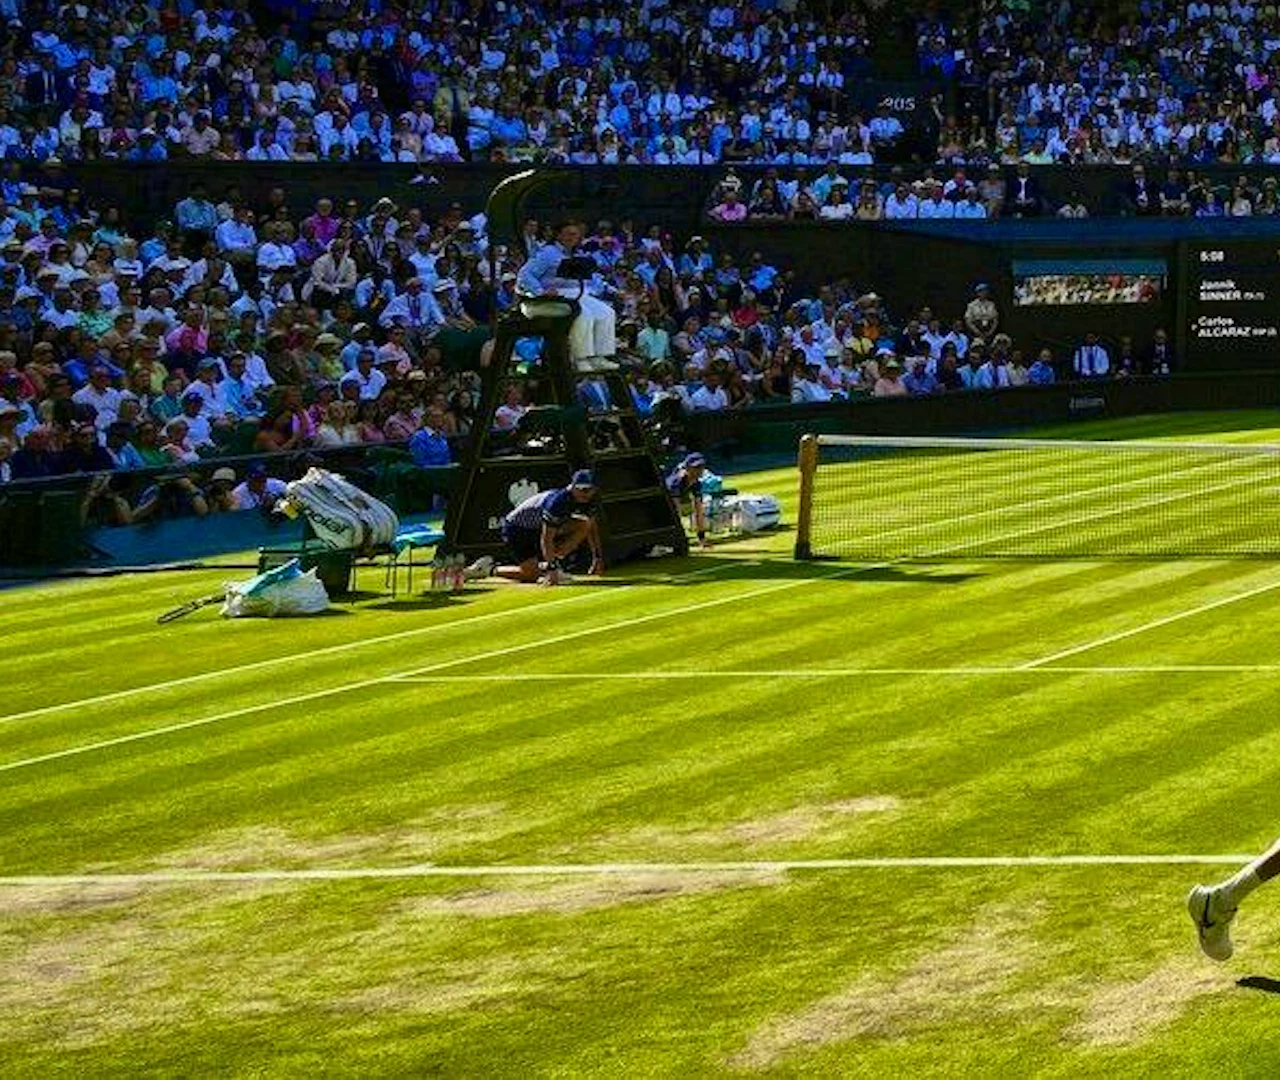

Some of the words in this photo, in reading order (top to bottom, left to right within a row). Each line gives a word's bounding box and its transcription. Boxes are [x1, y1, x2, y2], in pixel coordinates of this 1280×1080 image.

[1200, 279, 1236, 290] Jannik
[1200, 290, 1242, 301] SINNER
[1198, 316, 1235, 327] Carlos
[1198, 327, 1252, 338] ALCARAZ
